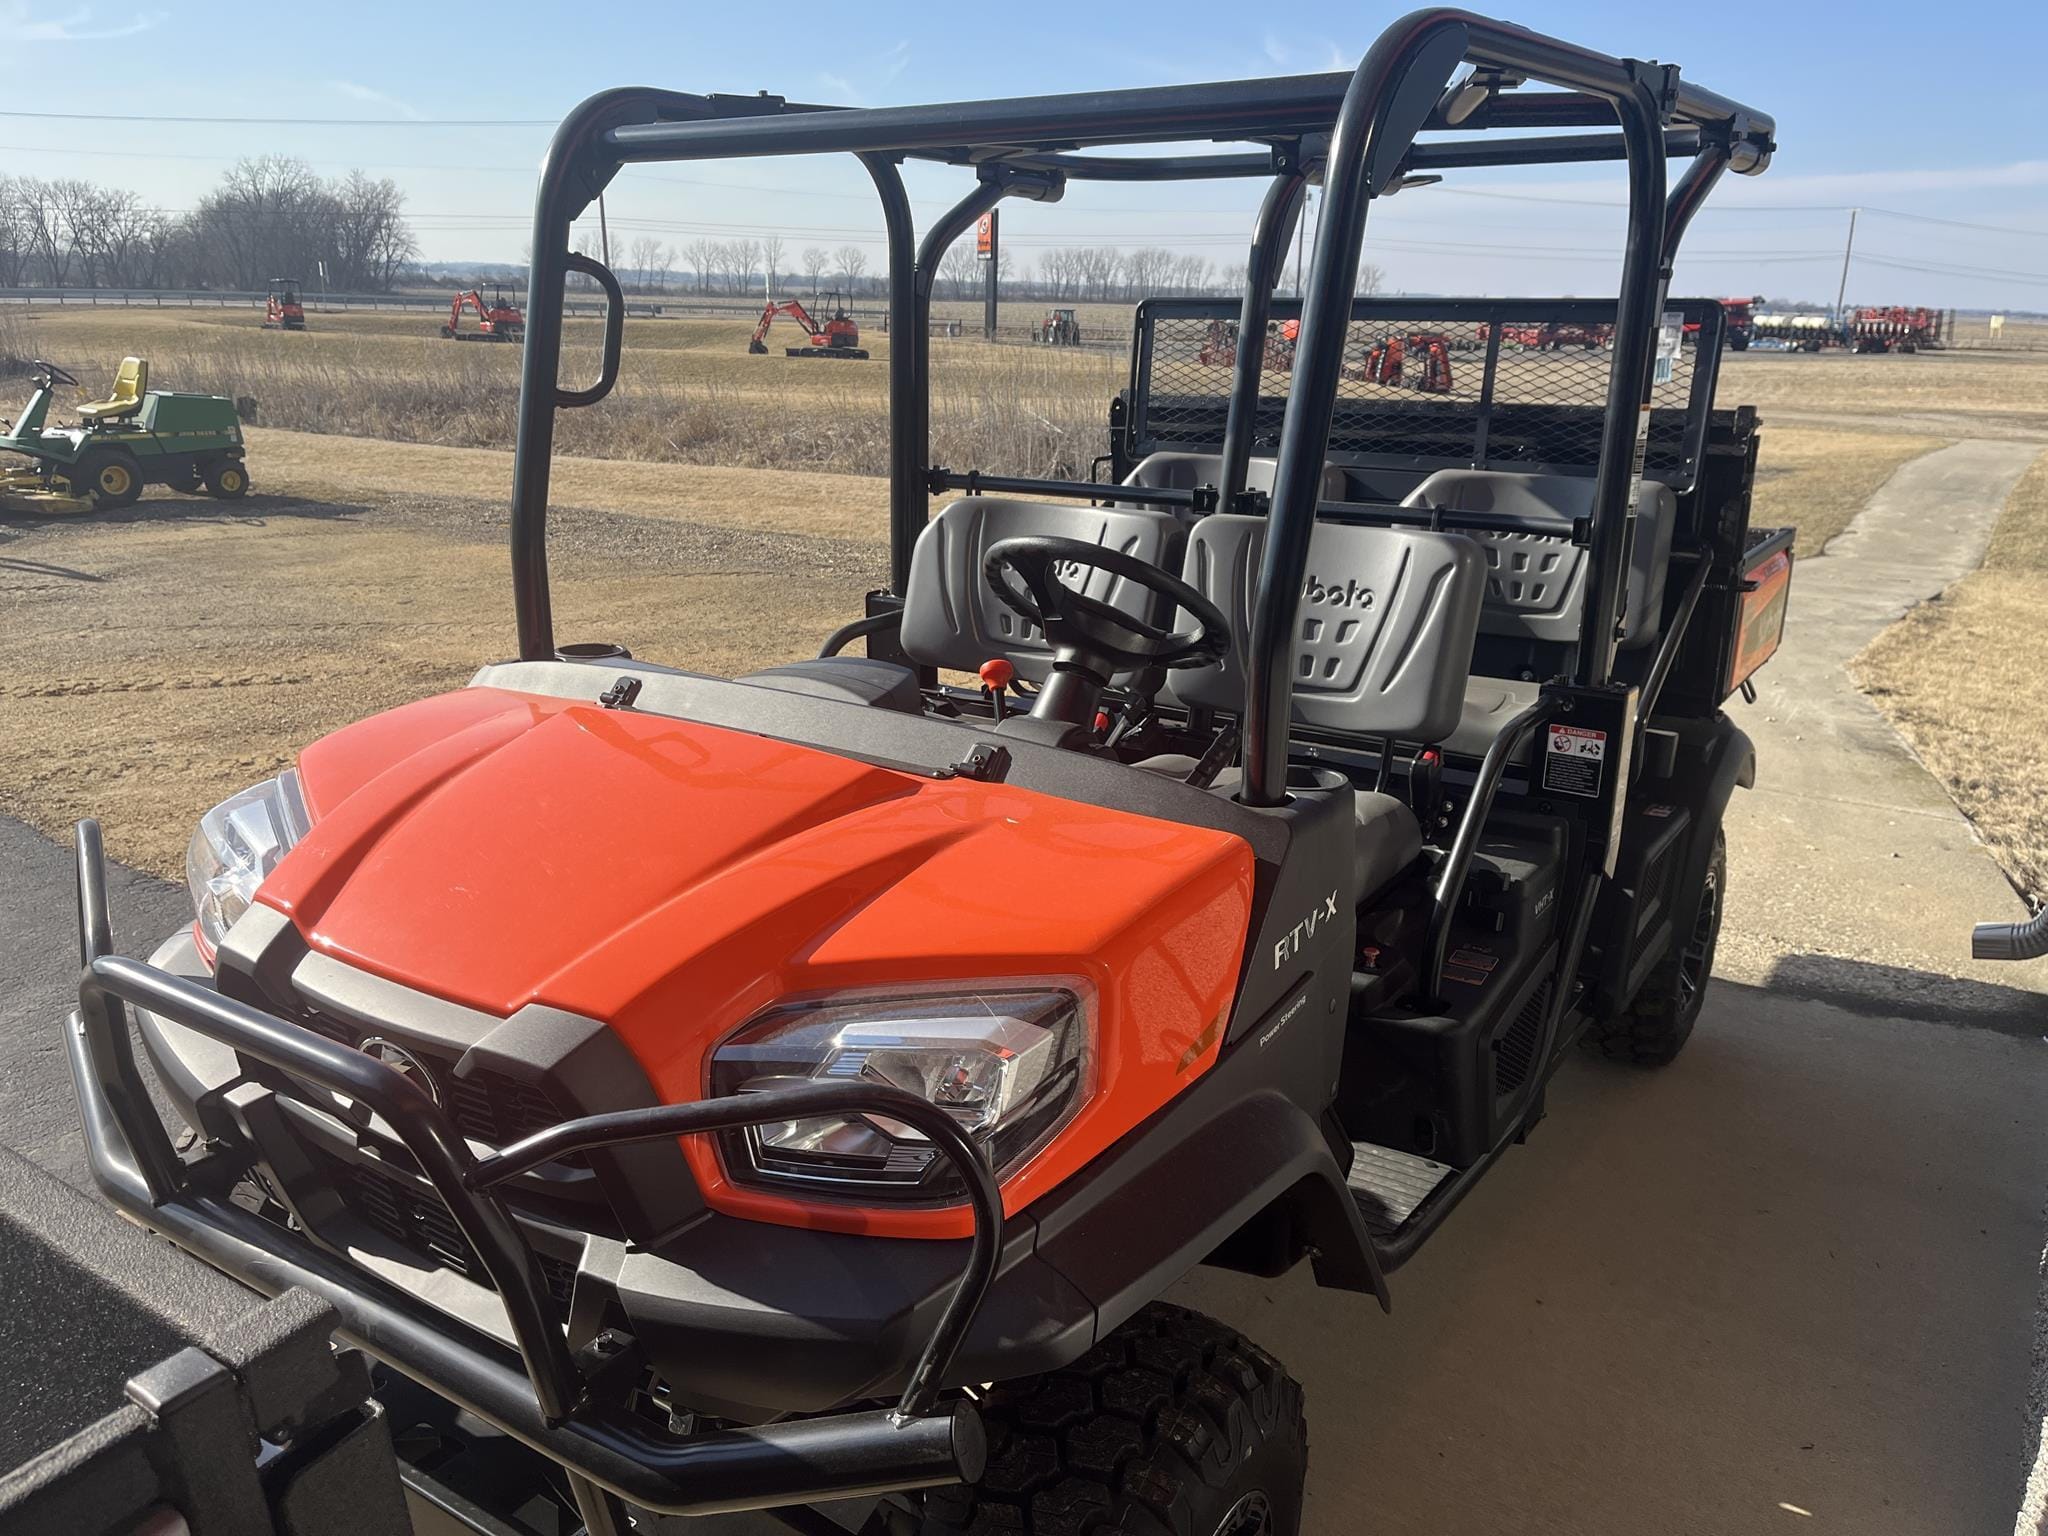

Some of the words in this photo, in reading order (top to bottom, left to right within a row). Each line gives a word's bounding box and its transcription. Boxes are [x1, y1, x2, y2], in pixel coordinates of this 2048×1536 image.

[1302, 575, 1376, 611] bota
[1567, 728, 1597, 739] DANGER
[1274, 888, 1338, 970] RTV-X
[1259, 1022, 1281, 1048] Power
[1280, 995, 1307, 1027] Steering
